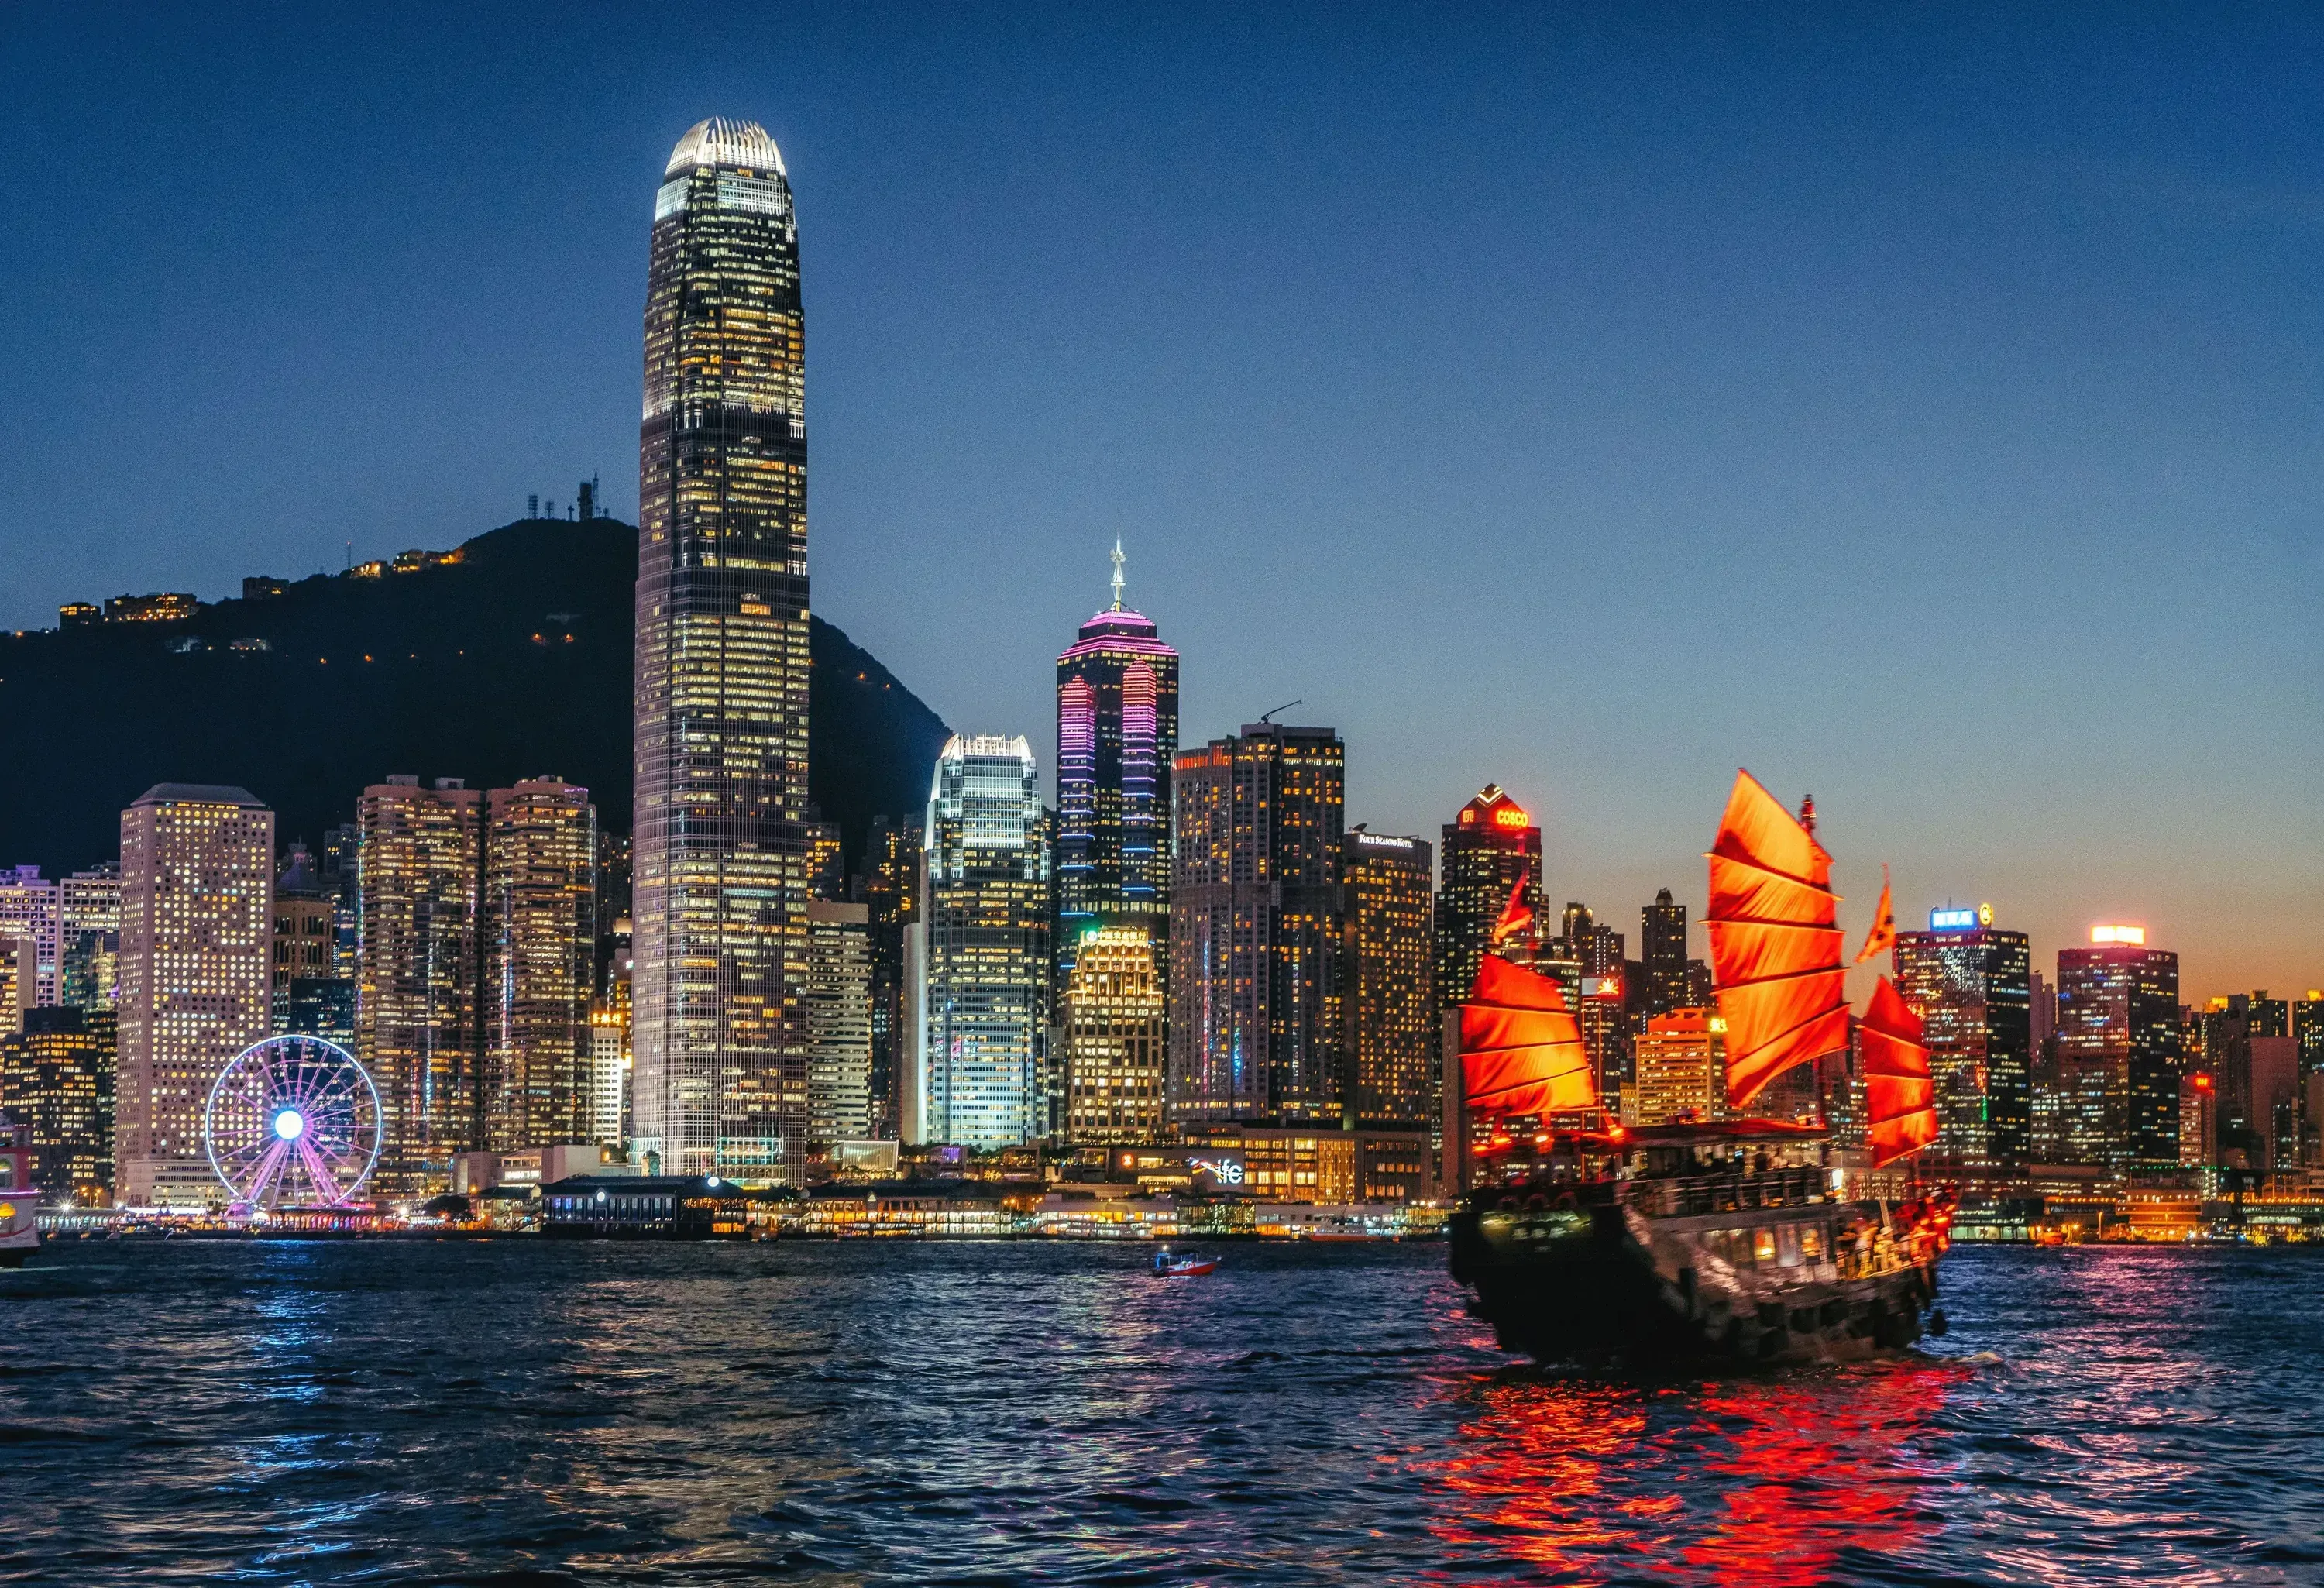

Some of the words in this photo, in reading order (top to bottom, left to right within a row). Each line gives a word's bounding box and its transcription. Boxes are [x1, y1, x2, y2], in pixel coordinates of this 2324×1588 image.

[1497, 810, 1528, 827] COSCO
[1359, 834, 1375, 844] FOUR
[1375, 836, 1397, 846] SEASONS
[1397, 838, 1413, 848] HOTEL
